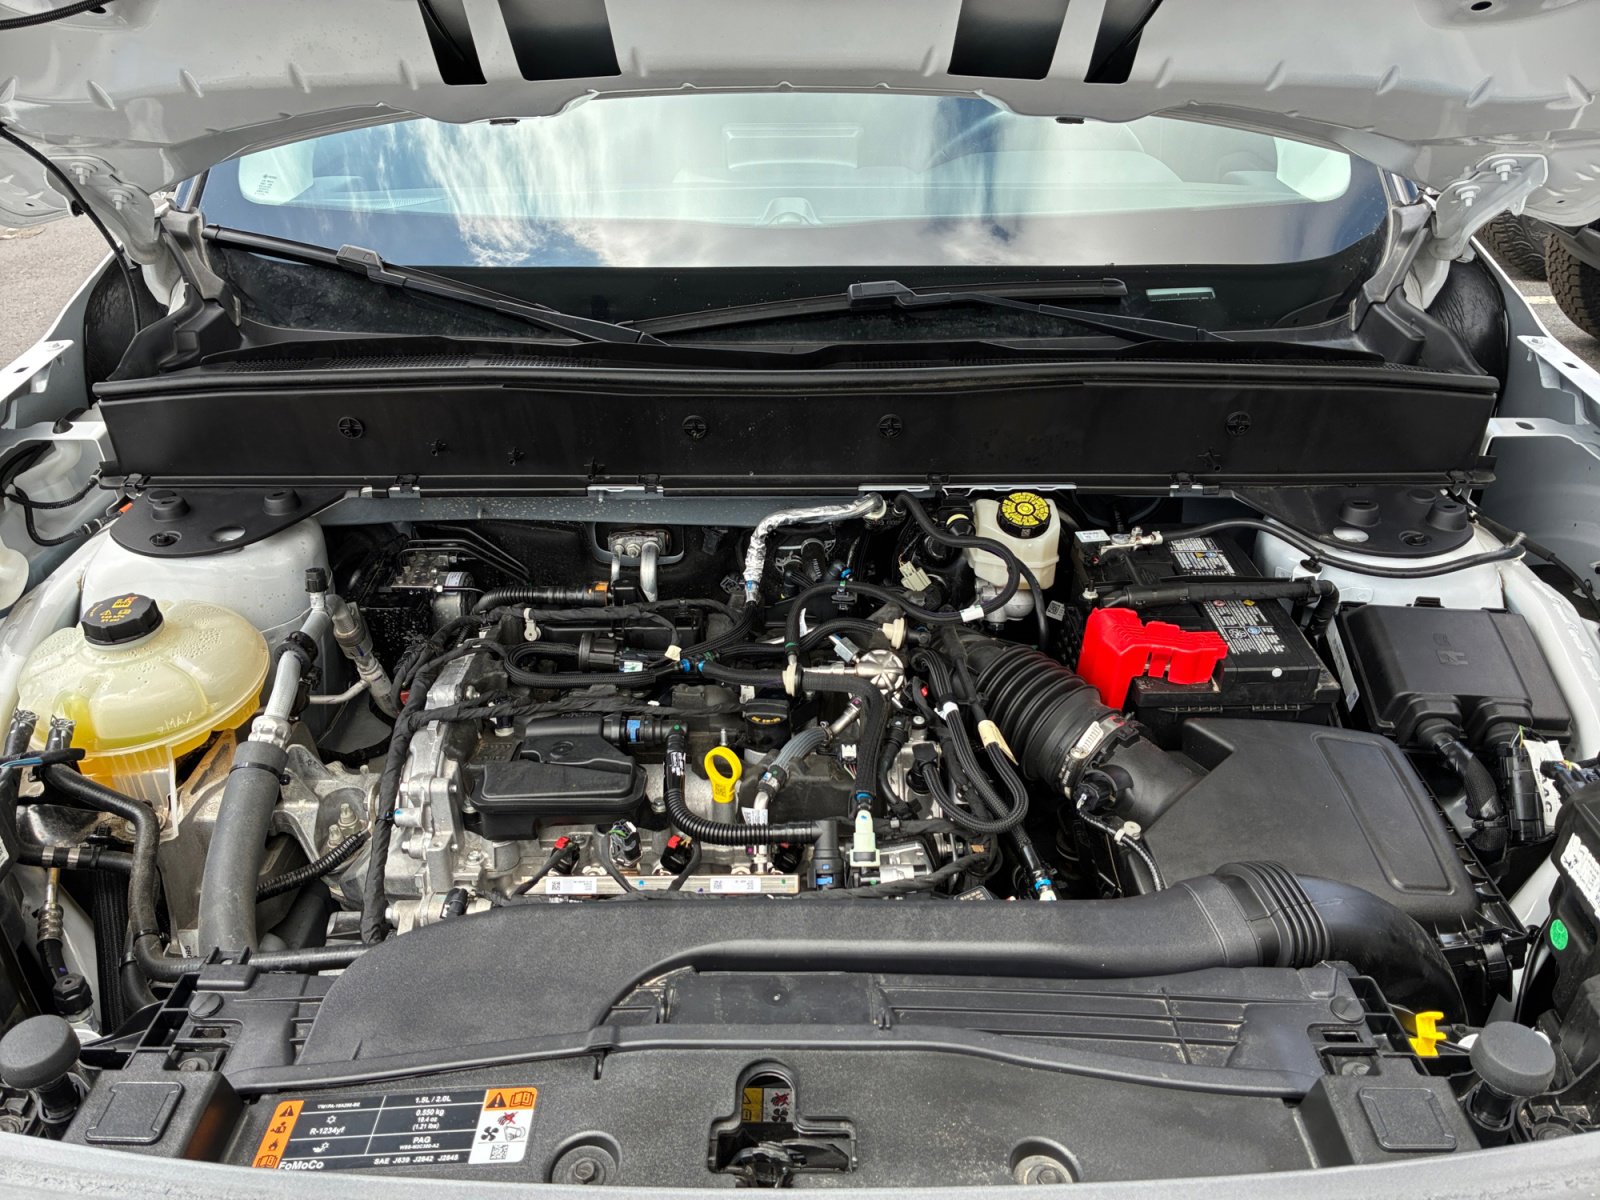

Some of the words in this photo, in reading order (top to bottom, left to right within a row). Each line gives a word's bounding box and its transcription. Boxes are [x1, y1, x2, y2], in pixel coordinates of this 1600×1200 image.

[415, 1108, 434, 1117] 0.550
[435, 1108, 445, 1117] kg
[309, 1125, 346, 1135] R-1234yf
[412, 1136, 431, 1144] PAG
[278, 1160, 324, 1170] FoMoCo
[373, 1157, 390, 1165] SAE
